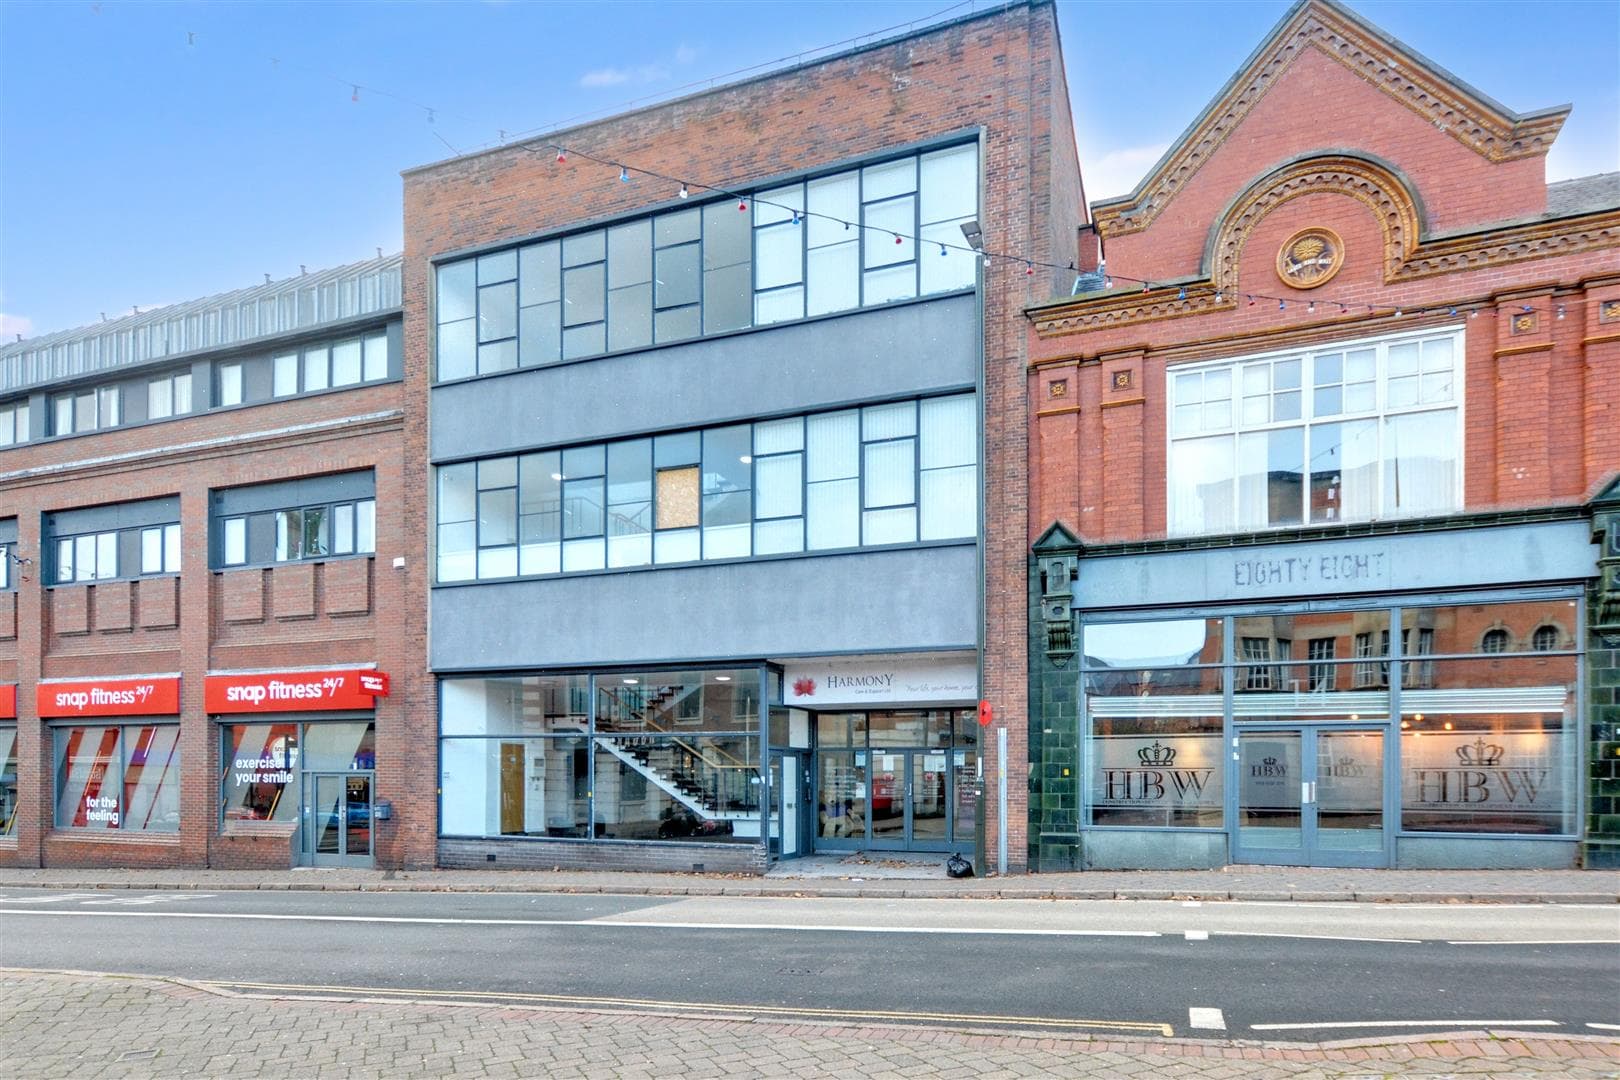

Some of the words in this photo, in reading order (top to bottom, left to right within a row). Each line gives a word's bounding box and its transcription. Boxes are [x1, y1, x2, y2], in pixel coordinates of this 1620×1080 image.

[1235, 558, 1312, 586] EIGHTY
[1320, 552, 1385, 580] EIGHT
[226, 685, 266, 705] snap
[268, 680, 323, 700] fitness
[323, 677, 345, 697] 24/7
[827, 673, 894, 689] HARMONY
[55, 691, 89, 711] snap
[90, 687, 136, 705] fitness
[135, 684, 155, 703] 24/7
[235, 756, 282, 769] exercise
[235, 773, 261, 787] your
[262, 770, 294, 784] smile
[1103, 770, 1216, 800] HBW
[1411, 770, 1549, 804] HBW
[86, 796, 100, 808] for
[101, 796, 118, 808] the
[86, 809, 119, 825] feeling
